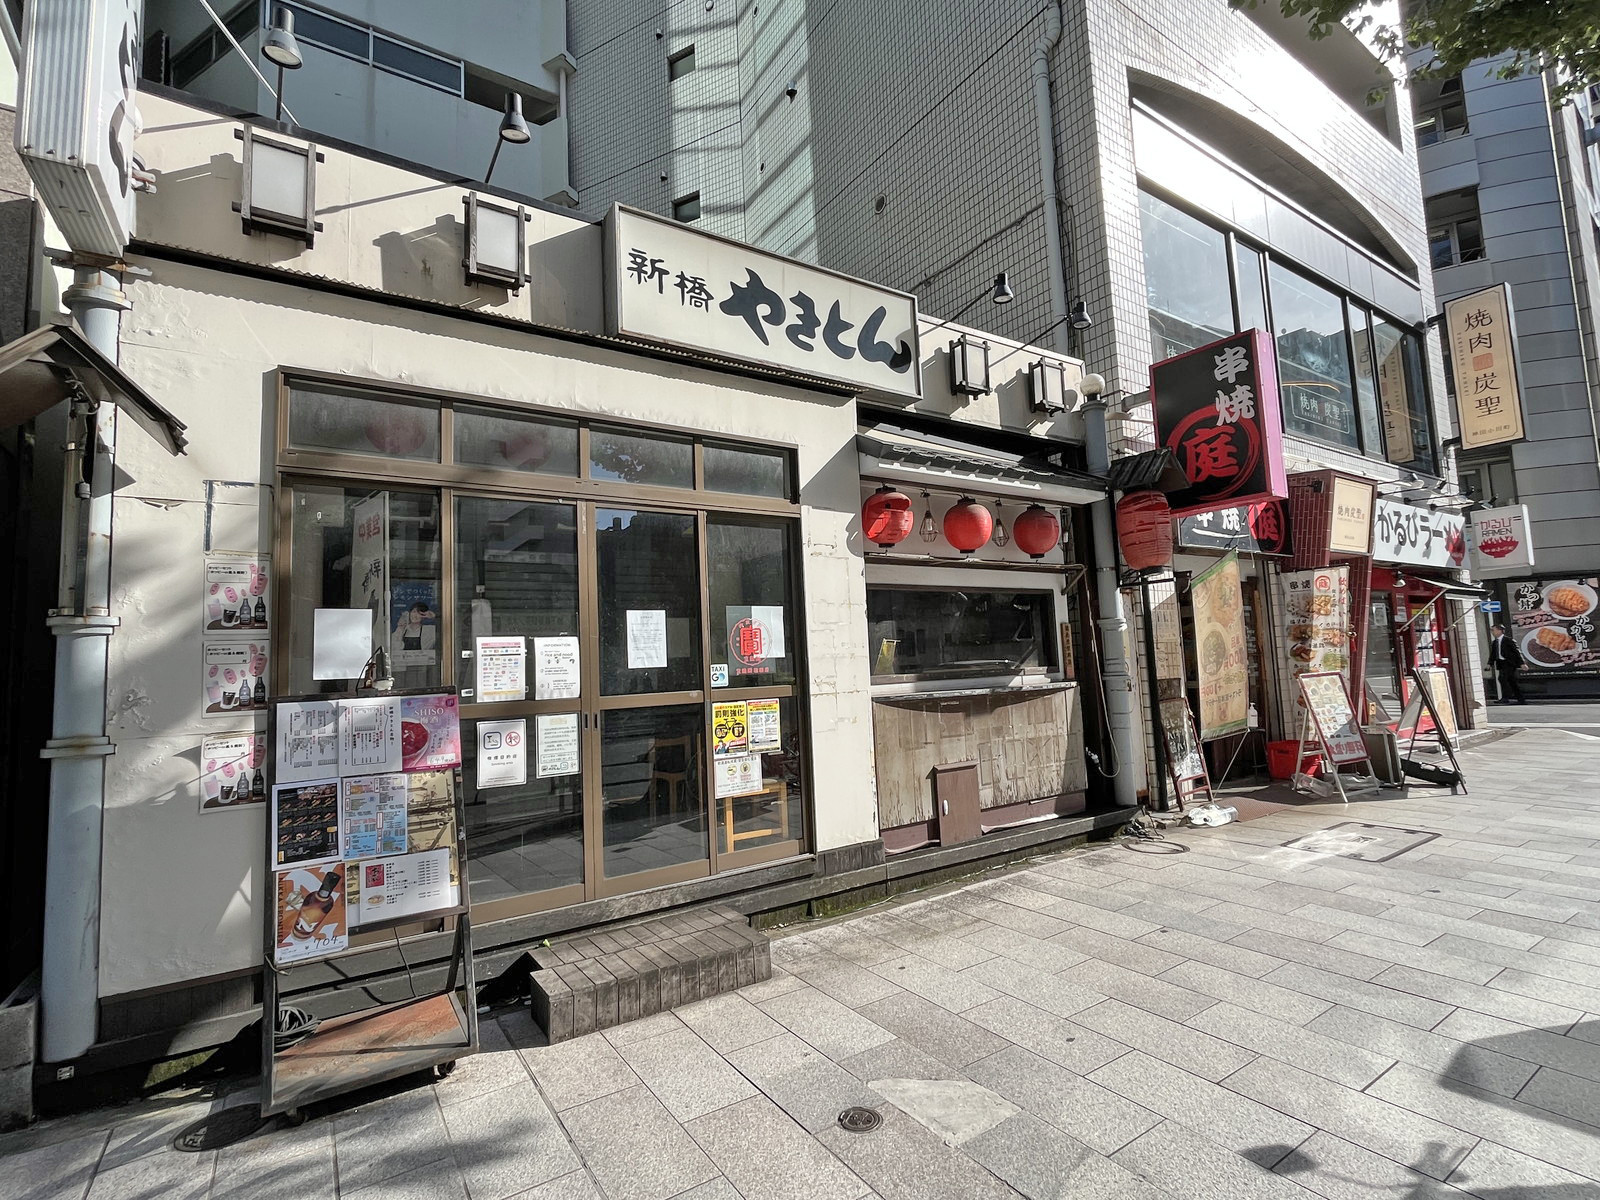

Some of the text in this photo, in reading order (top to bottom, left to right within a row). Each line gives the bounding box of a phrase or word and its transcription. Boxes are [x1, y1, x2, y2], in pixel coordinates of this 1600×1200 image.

[627, 247, 912, 374] 新橋 やきとん
[1464, 308, 1503, 419] 焼肉 炭聖
[1213, 346, 1256, 427] 串焼
[1183, 426, 1240, 482] 庭
[1480, 517, 1512, 530] かるび
[1482, 527, 1513, 537] RAMEN
[1289, 579, 1311, 590] 串焼
[1517, 583, 1540, 611] かつ丼
[711, 672, 726, 682] GO
[414, 707, 444, 716] SHISO
